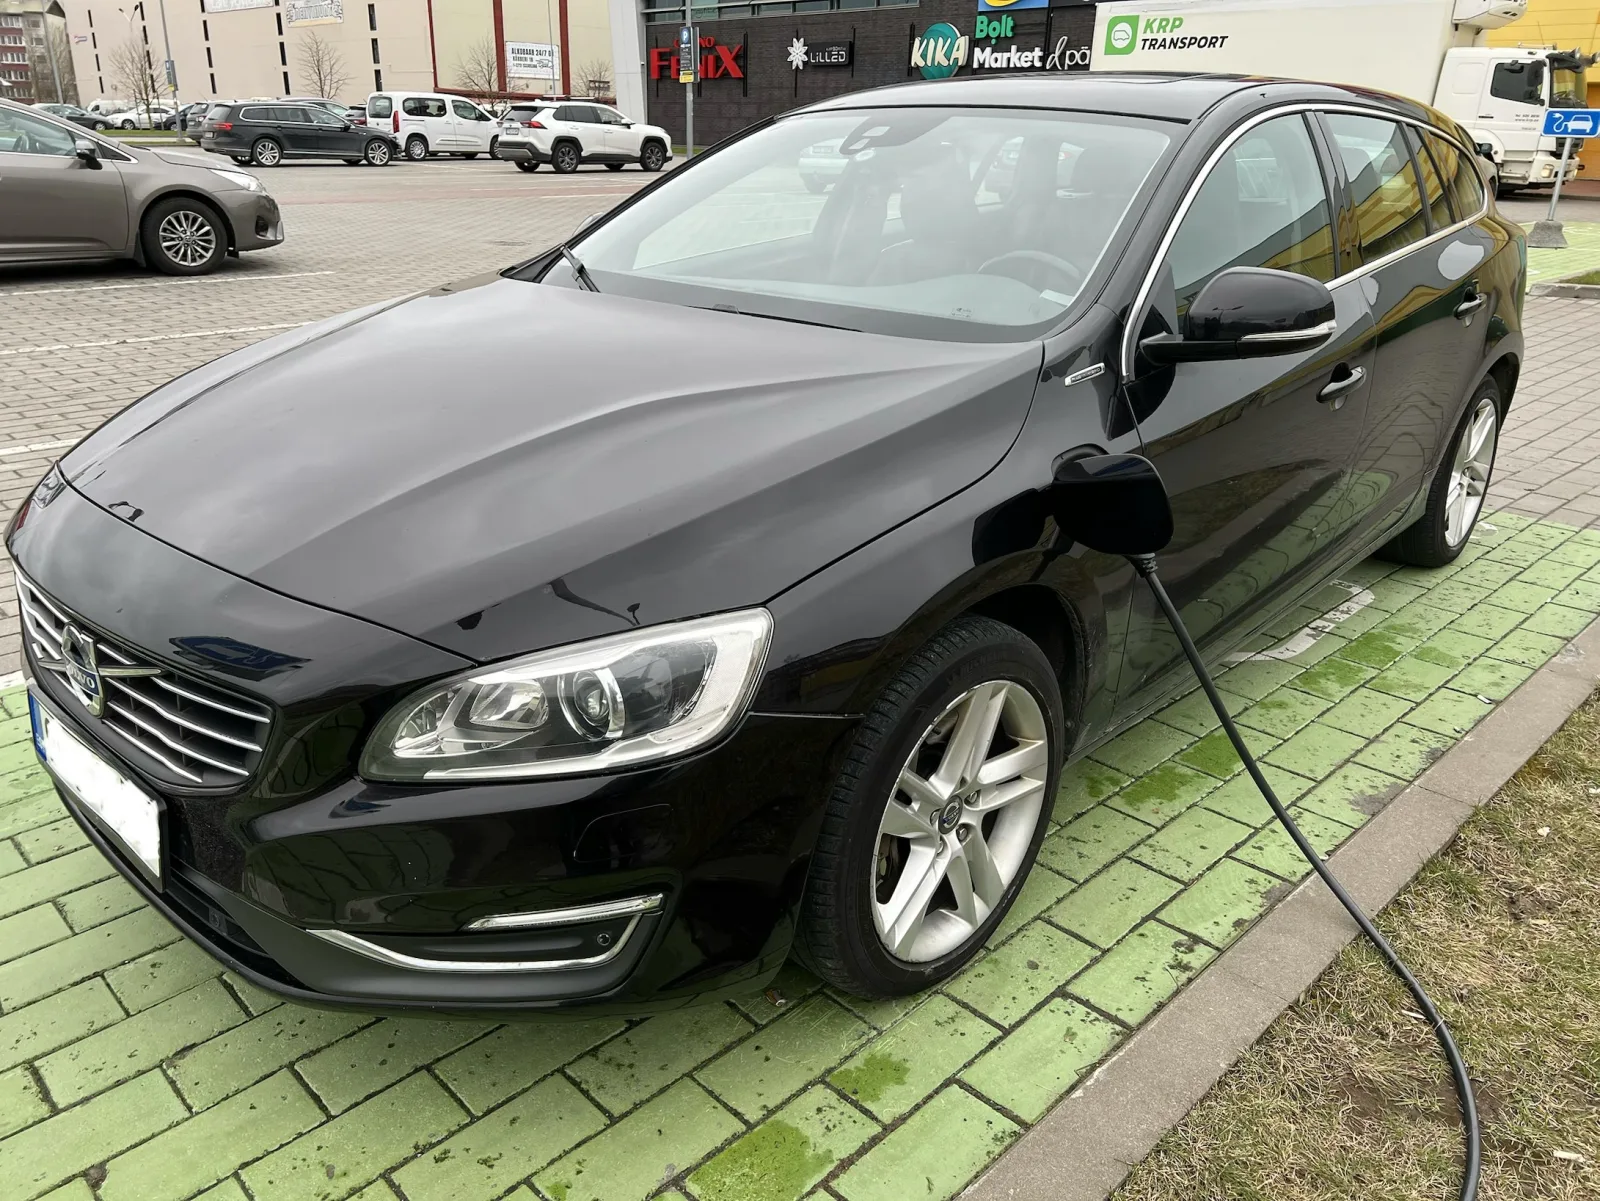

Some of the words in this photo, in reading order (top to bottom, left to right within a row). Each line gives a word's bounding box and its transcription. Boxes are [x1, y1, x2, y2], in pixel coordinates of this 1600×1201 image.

[1143, 17, 1184, 34] KRP
[911, 35, 969, 67] KIKA
[1141, 35, 1229, 50] TRANSPORT
[973, 45, 1044, 69] Market
